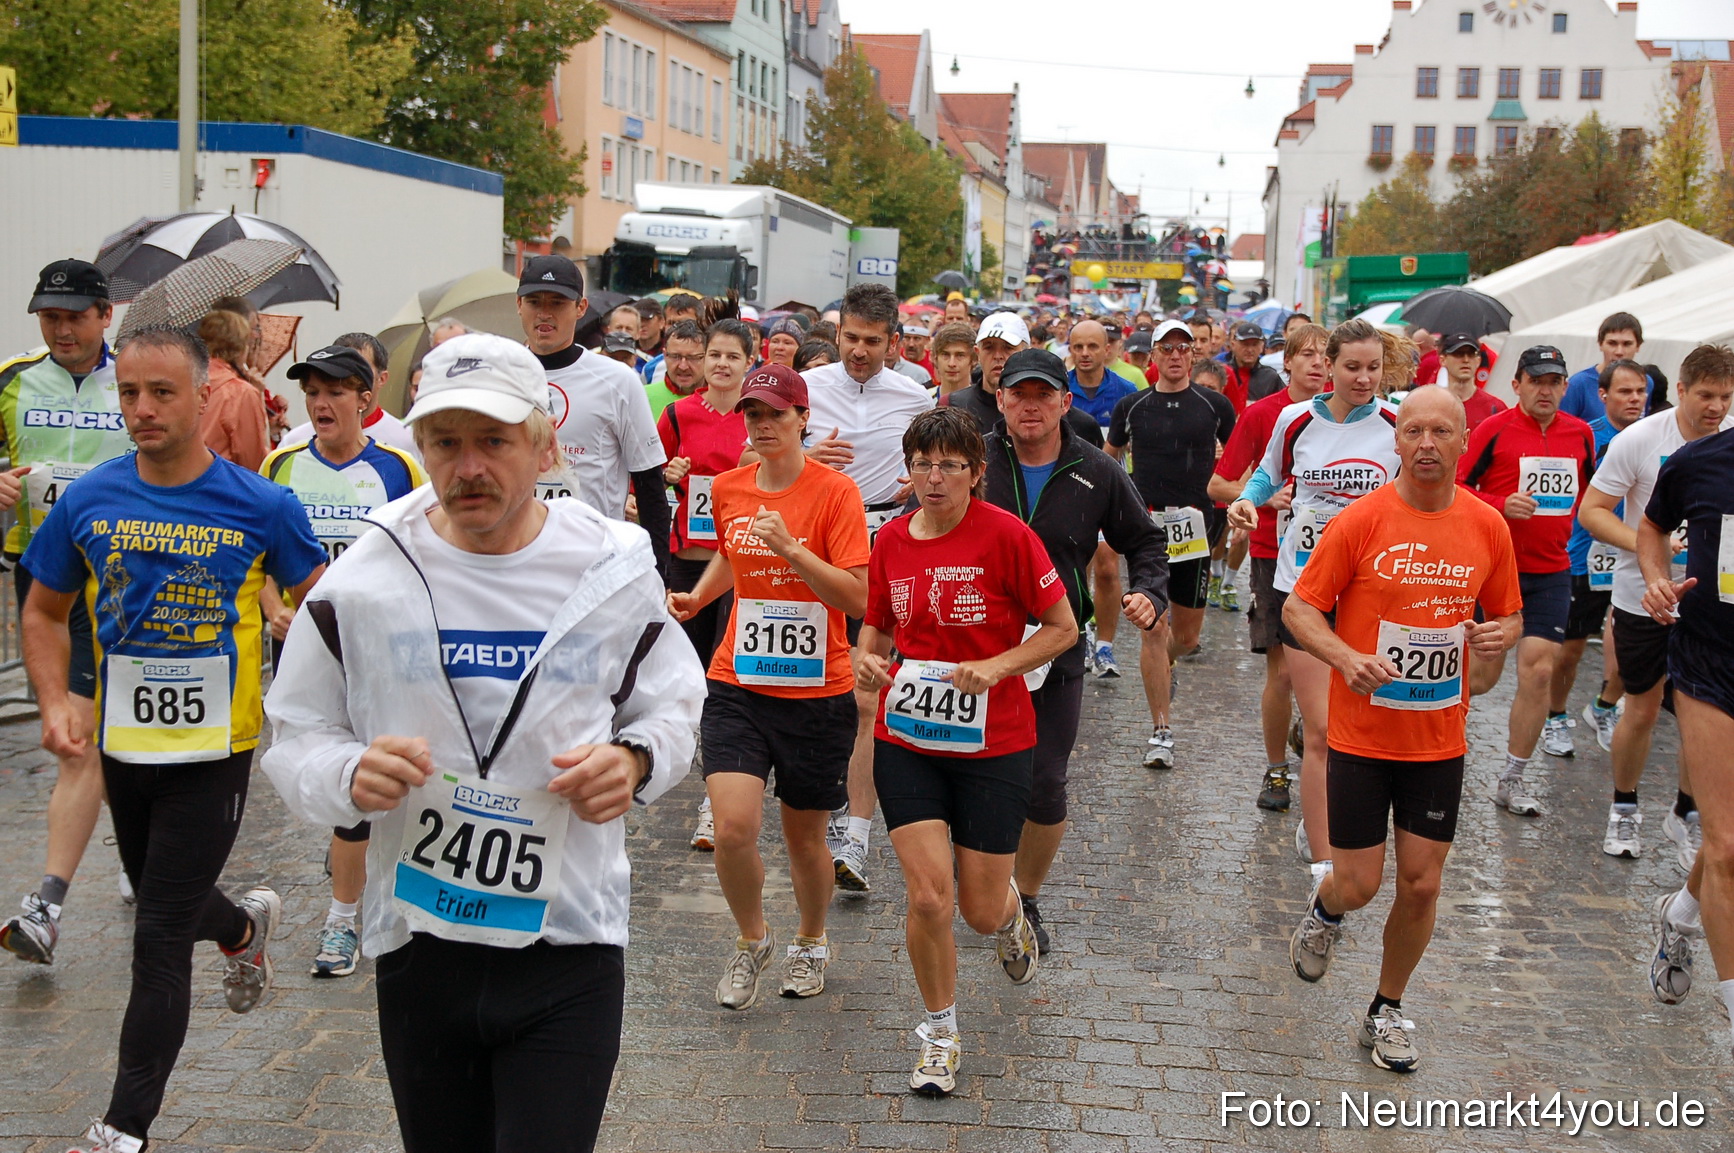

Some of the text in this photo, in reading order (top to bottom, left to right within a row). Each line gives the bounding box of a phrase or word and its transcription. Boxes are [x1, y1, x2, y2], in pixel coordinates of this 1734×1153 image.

[647, 224, 709, 239] BOCK
[1106, 264, 1145, 276] START
[31, 394, 92, 408] TEAM
[24, 408, 124, 431] BOCK
[1302, 469, 1374, 480] GERHART
[1526, 472, 1573, 494] 2632
[300, 491, 346, 503] TEAM
[91, 519, 245, 548] 10. NEUMARKTER
[110, 534, 218, 558] STADTLAUF
[749, 566, 766, 577] und
[767, 566, 782, 576] das
[924, 566, 984, 576] 11. NEUMARKTER
[1392, 558, 1475, 579] Fischer
[932, 573, 975, 582] STADTLAUF
[1400, 576, 1468, 588] AUTOMOBILE
[953, 604, 987, 613] 19.09.2010
[1411, 598, 1428, 609] und
[1430, 595, 1448, 605] das
[152, 606, 227, 623] 20.09.2009
[763, 605, 799, 616] BOCK
[743, 622, 817, 656] 3163
[1408, 632, 1449, 642] BOCK
[143, 664, 191, 676] BOCK
[755, 660, 798, 674] Andrea
[1387, 646, 1459, 681] 3208
[1409, 686, 1435, 699] Kurt
[133, 685, 206, 726] 685
[894, 682, 978, 724] 2449
[914, 723, 951, 739] Maria
[453, 785, 521, 812] BOCK
[411, 807, 547, 893] 2405
[435, 887, 488, 920] Erich
